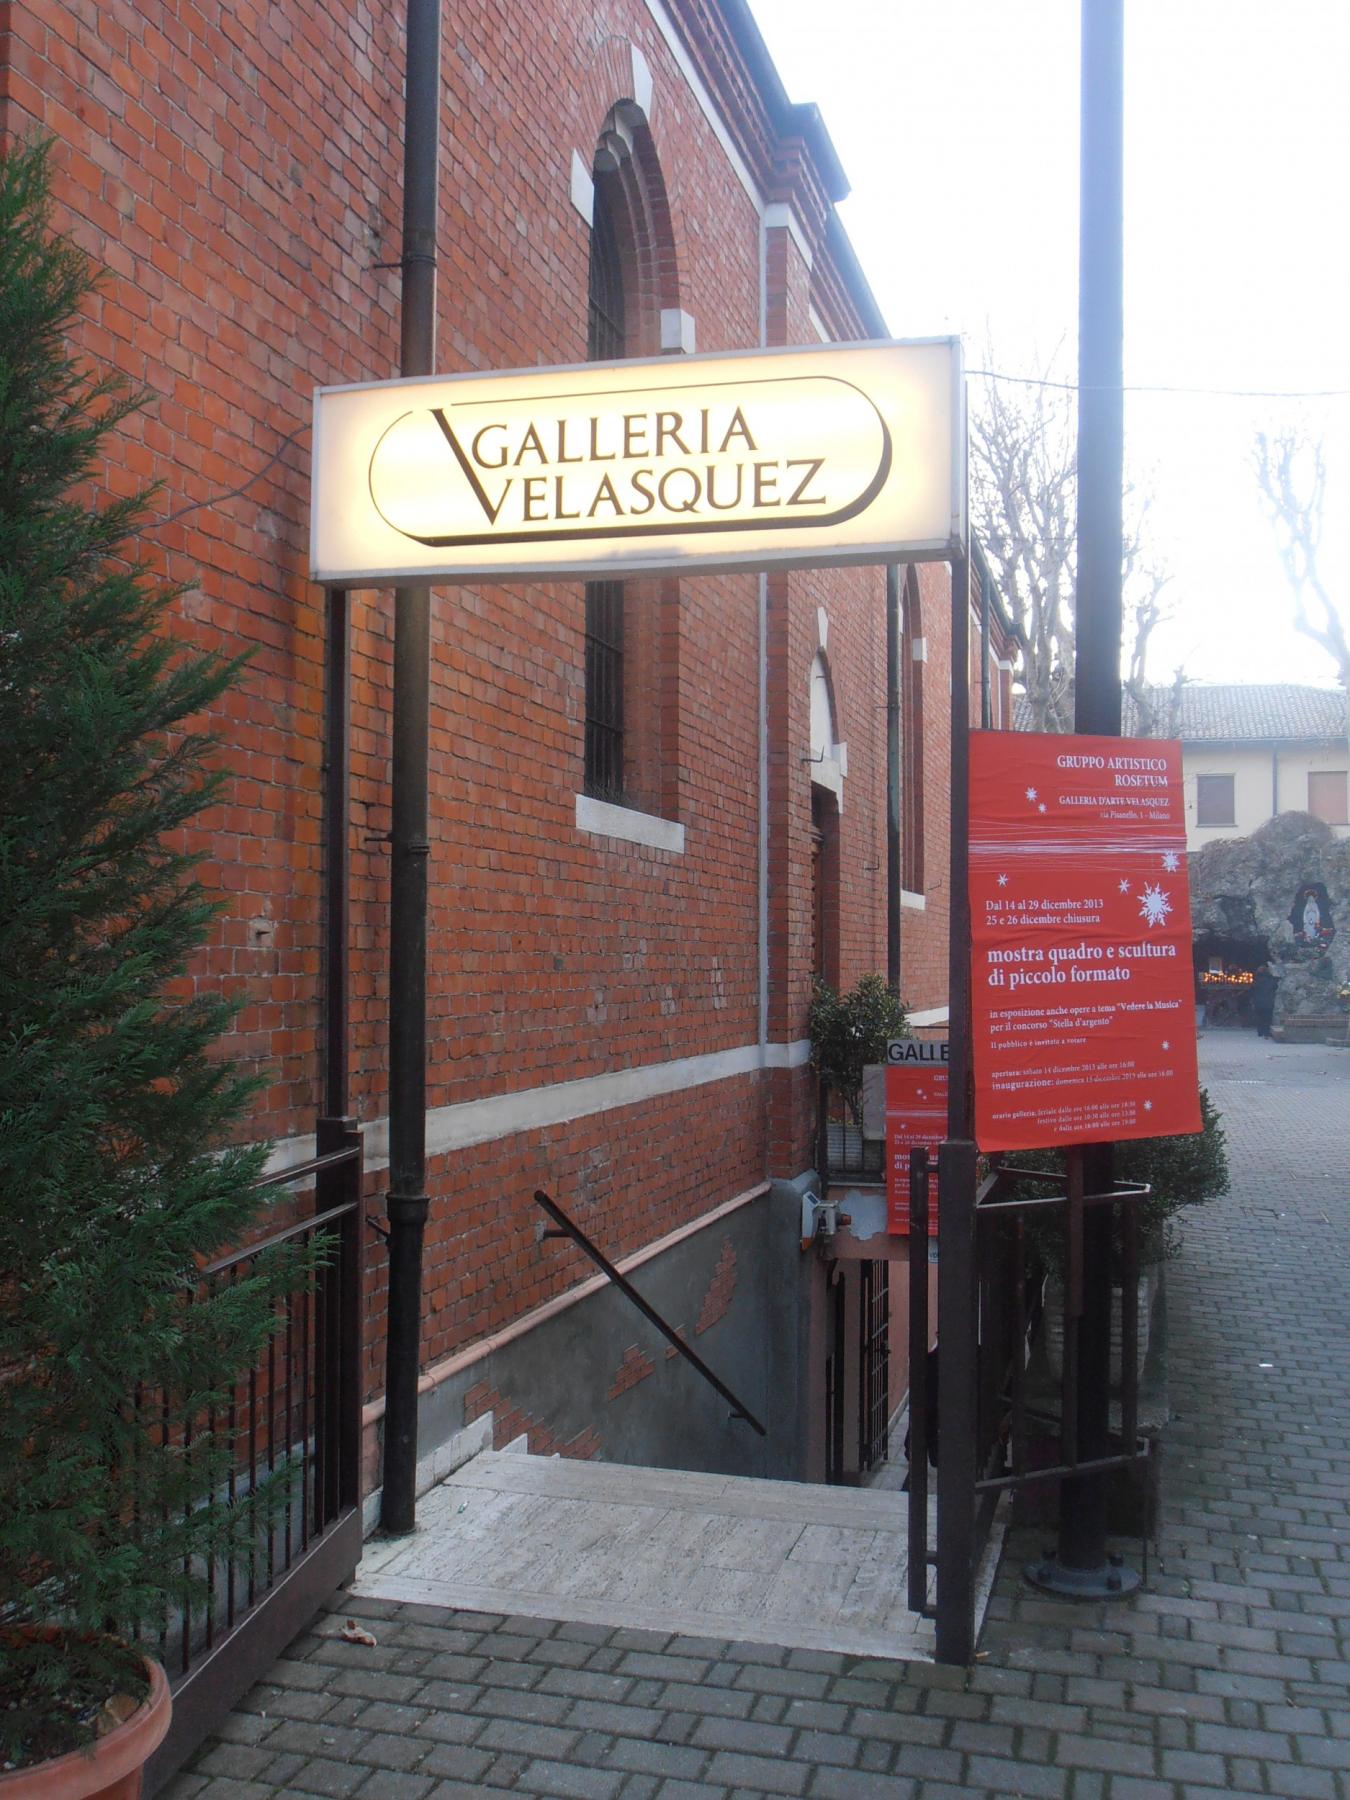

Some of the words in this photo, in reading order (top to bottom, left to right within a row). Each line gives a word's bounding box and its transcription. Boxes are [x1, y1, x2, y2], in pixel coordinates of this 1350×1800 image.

[471, 406, 759, 471] GALLERIA
[428, 408, 827, 526] VELASQUEZ
[1057, 755, 1104, 769] GRUPPO
[1107, 757, 1167, 771] ARTISTICO
[1115, 774, 1168, 787] ROSETUM
[1059, 795, 1097, 805] GALLERIA
[1126, 797, 1169, 807] VELASQUEZ
[985, 900, 1002, 911] Dal
[1005, 900, 1015, 910] 14
[1017, 900, 1026, 910] al
[1028, 900, 1039, 910] 29
[1041, 899, 1082, 909] dicembre
[1083, 899, 1104, 909] 2013
[986, 915, 997, 925] 25
[999, 917, 1005, 925] e
[1007, 915, 1018, 925] 26
[1020, 914, 1061, 924] dicembre
[1063, 913, 1100, 923] chiusura
[988, 946, 1044, 963] mostra
[1048, 943, 1102, 965] quadro
[1106, 946, 1114, 958] e
[1118, 941, 1176, 958] scultura
[988, 968, 1004, 986] di
[1009, 966, 1066, 990] piccolo
[1070, 965, 1130, 982] formato
[990, 1009, 998, 1019] in
[1000, 1008, 1045, 1020] esposizione
[1046, 1006, 1069, 1017] anche
[1070, 1007, 1090, 1018] opere
[1091, 1006, 1096, 1014] a
[1098, 1005, 1116, 1013] tema
[990, 1023, 1003, 1034] per
[1005, 1021, 1011, 1031] il
[1013, 1022, 1048, 1031] concorso
[991, 1041, 997, 1049] Il
[998, 1039, 1028, 1050] pubblico
[888, 1043, 949, 1061] GALLE
[992, 1078, 1054, 1092] inaugurazione:
